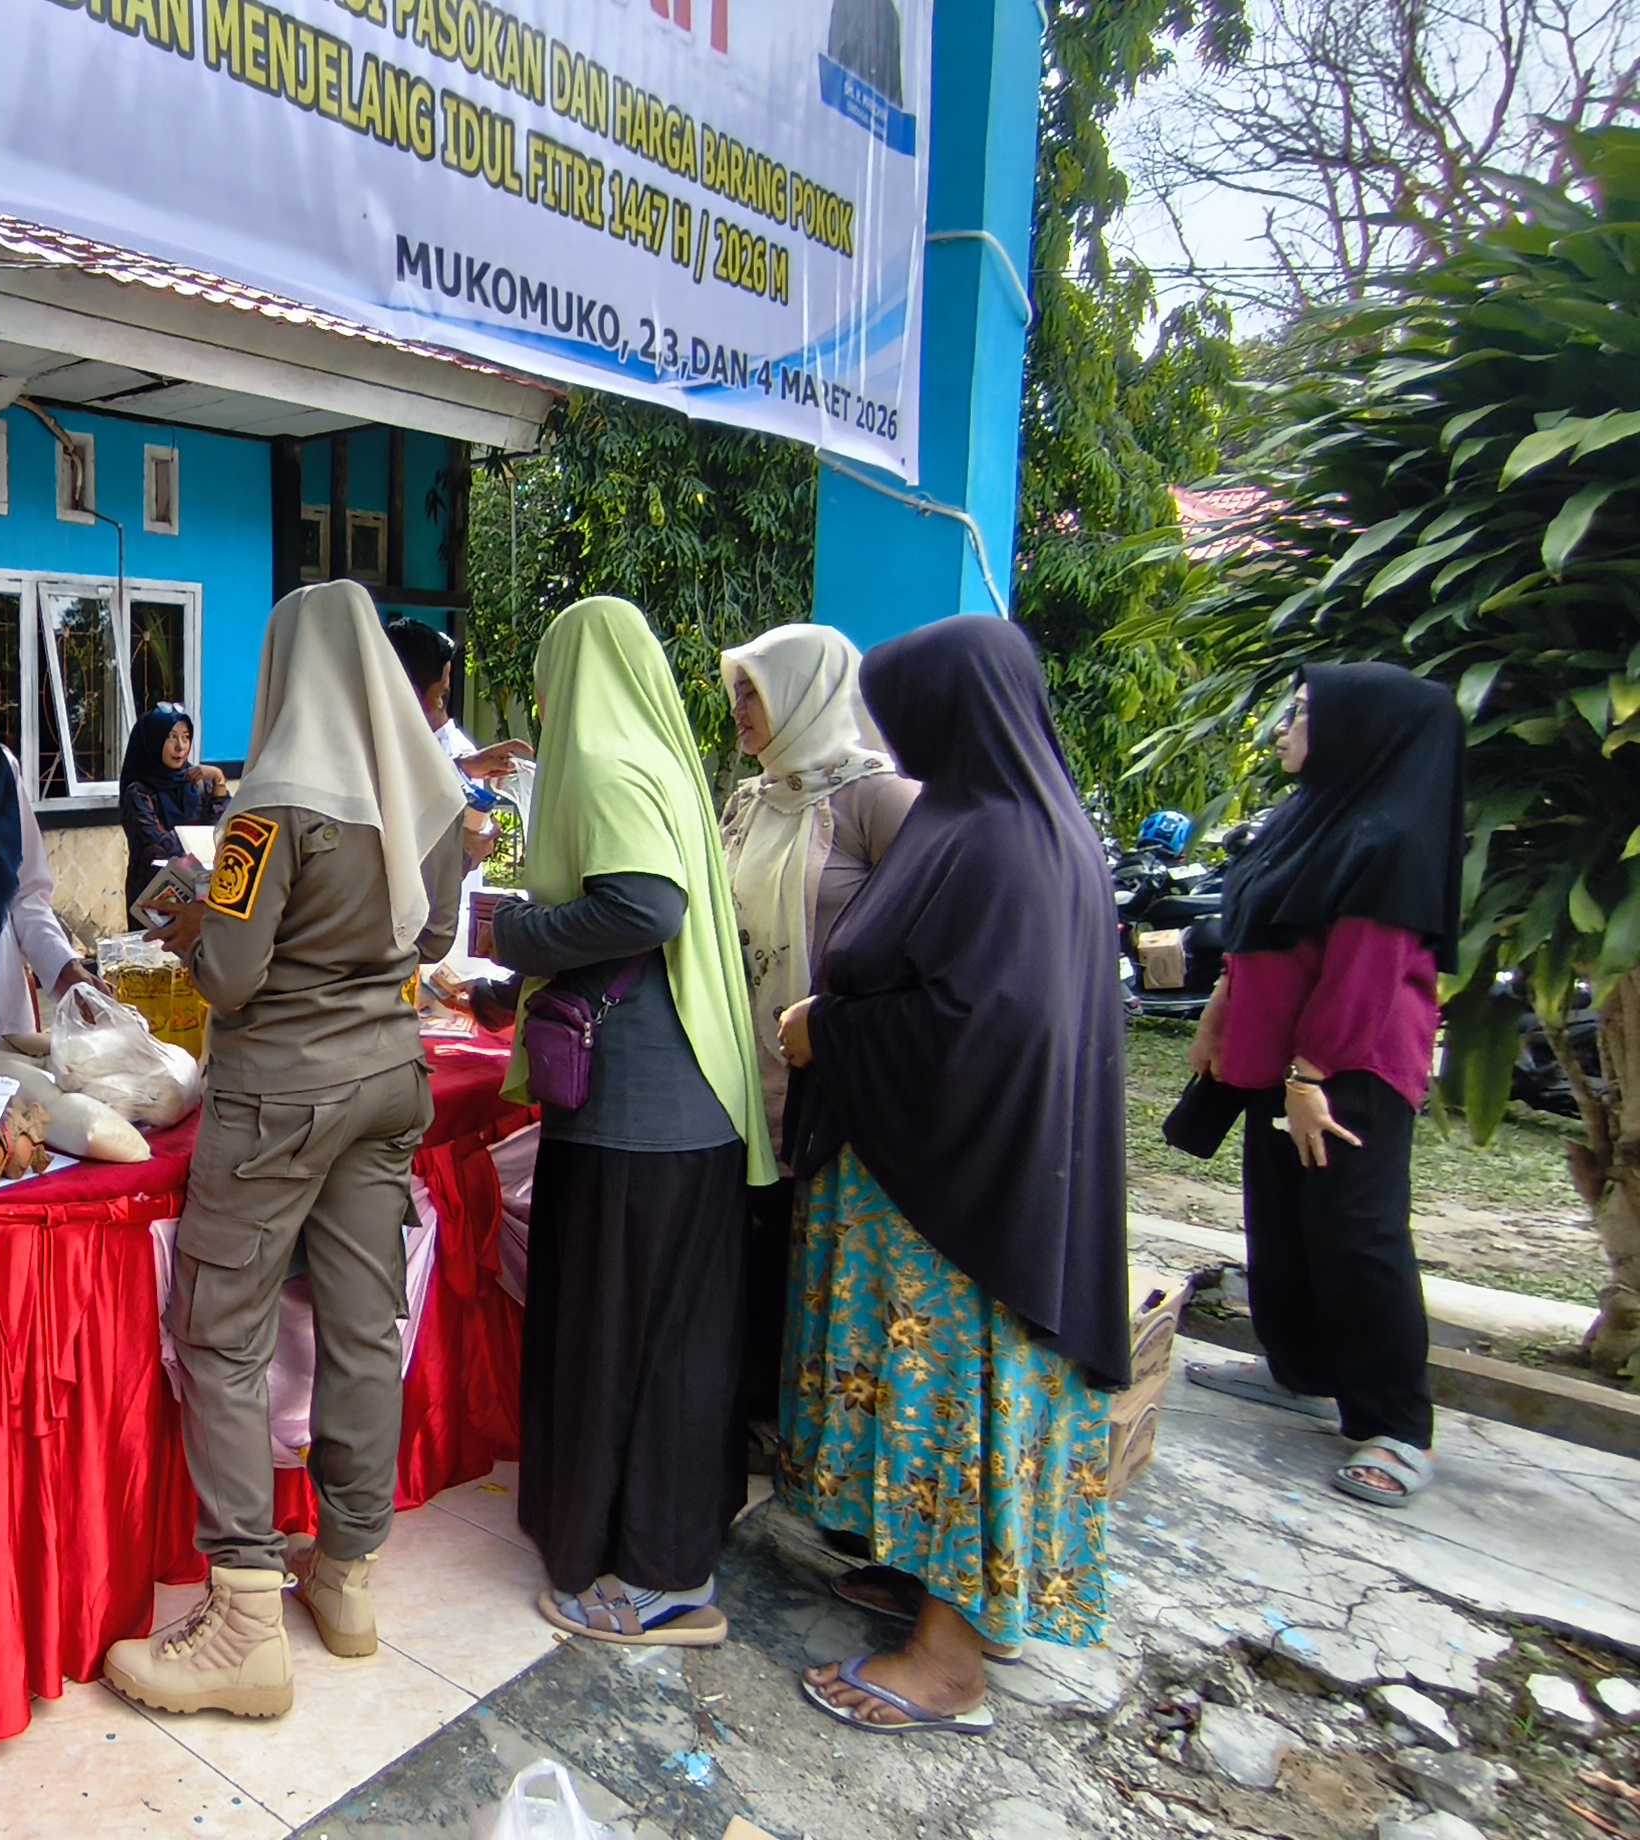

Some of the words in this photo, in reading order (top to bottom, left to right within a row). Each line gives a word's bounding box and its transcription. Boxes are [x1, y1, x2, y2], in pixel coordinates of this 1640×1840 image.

[202, 0, 434, 161] MENJELANG
[441, 89, 523, 197] IDUL
[526, 128, 605, 231] FITRI
[610, 169, 669, 257] 1447
[672, 198, 692, 268] H
[693, 209, 709, 284] /
[713, 217, 767, 297] 2026
[769, 242, 789, 306] M
[550, 38, 608, 138] DAN
[612, 75, 698, 183] HARGA
[701, 122, 788, 225] BARANG
[790, 171, 854, 258] POKOK
[396, 233, 629, 362] MUKOMUKO,
[756, 360, 772, 395] 4
[780, 366, 852, 422] MARET
[856, 396, 898, 441] 2026
